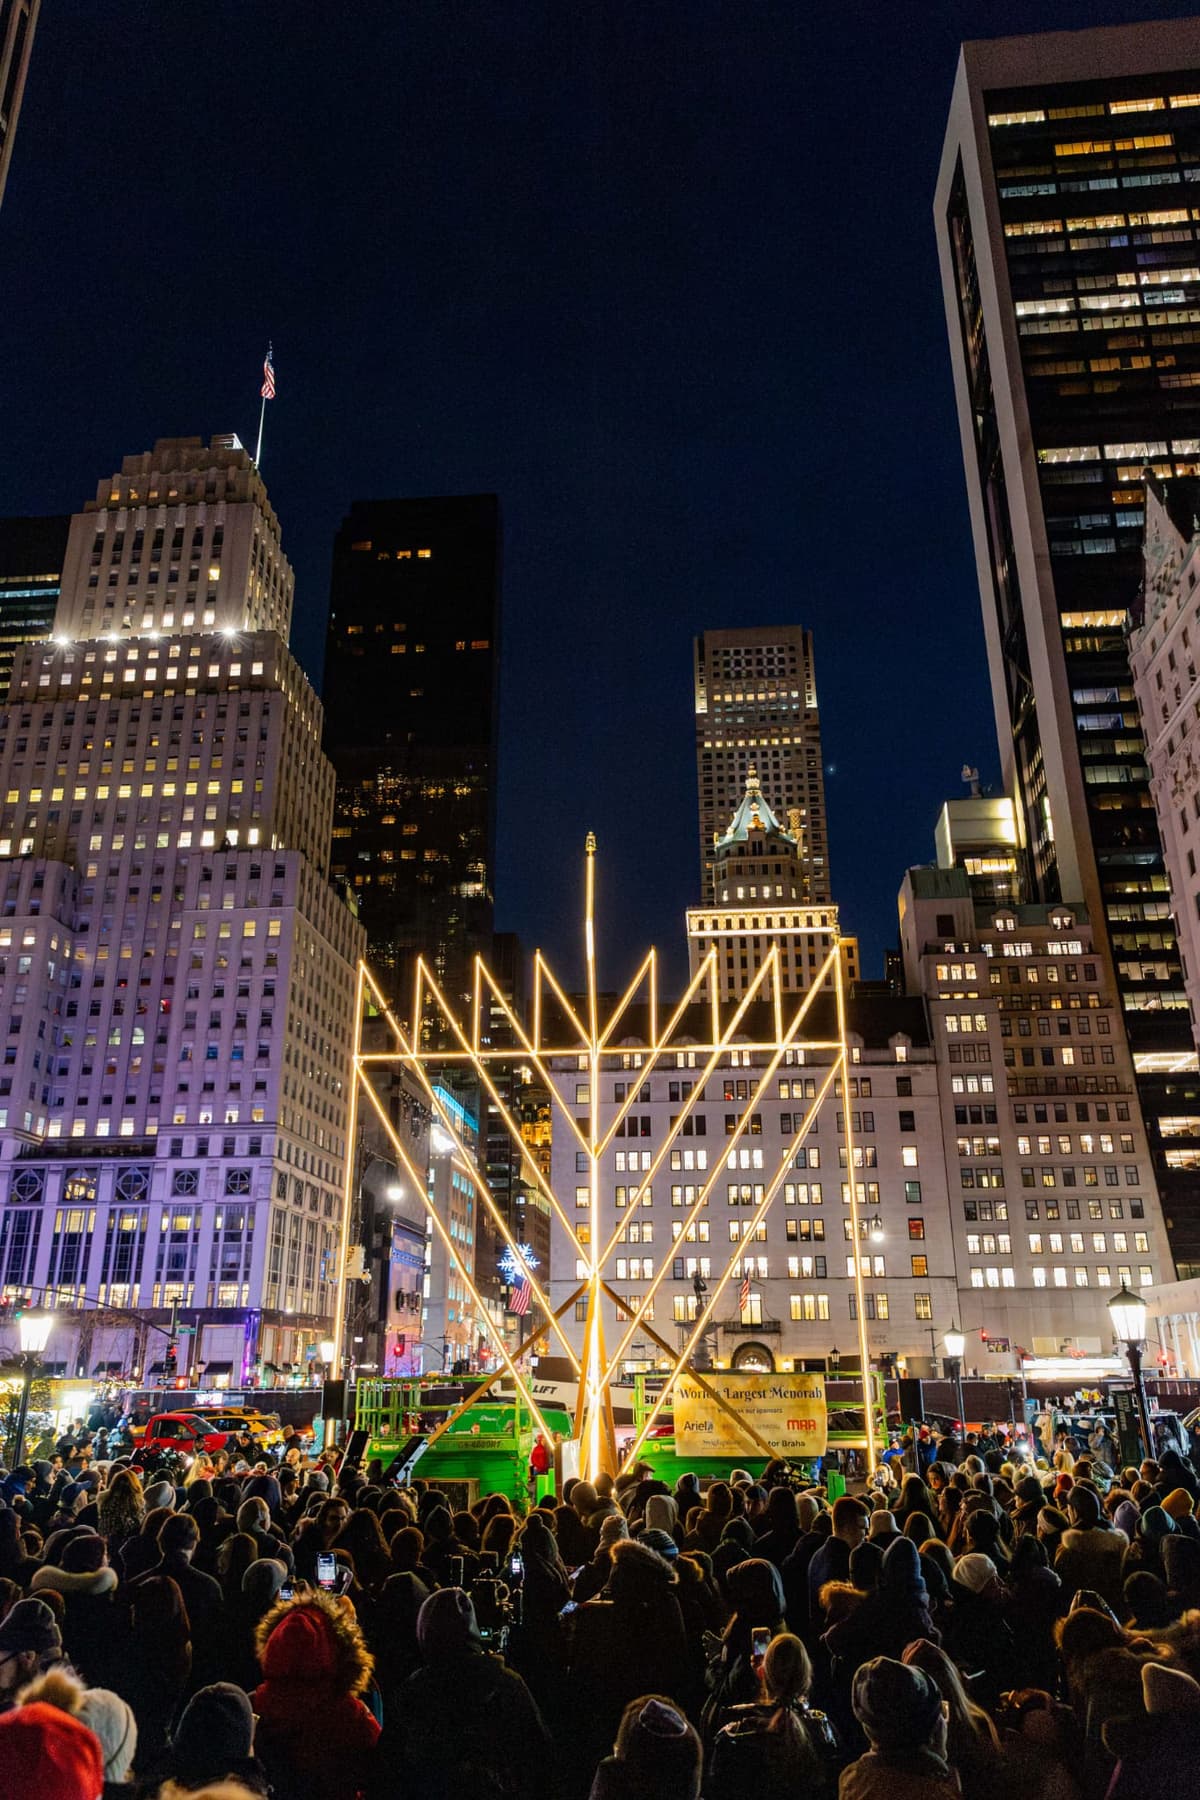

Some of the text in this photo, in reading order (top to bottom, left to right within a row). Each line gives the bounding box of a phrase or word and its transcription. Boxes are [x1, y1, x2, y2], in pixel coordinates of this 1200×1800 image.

[532, 1384, 557, 1395] LIFT
[677, 1386, 822, 1402] Worl Largest Menorah
[782, 1439, 806, 1448] Braha
